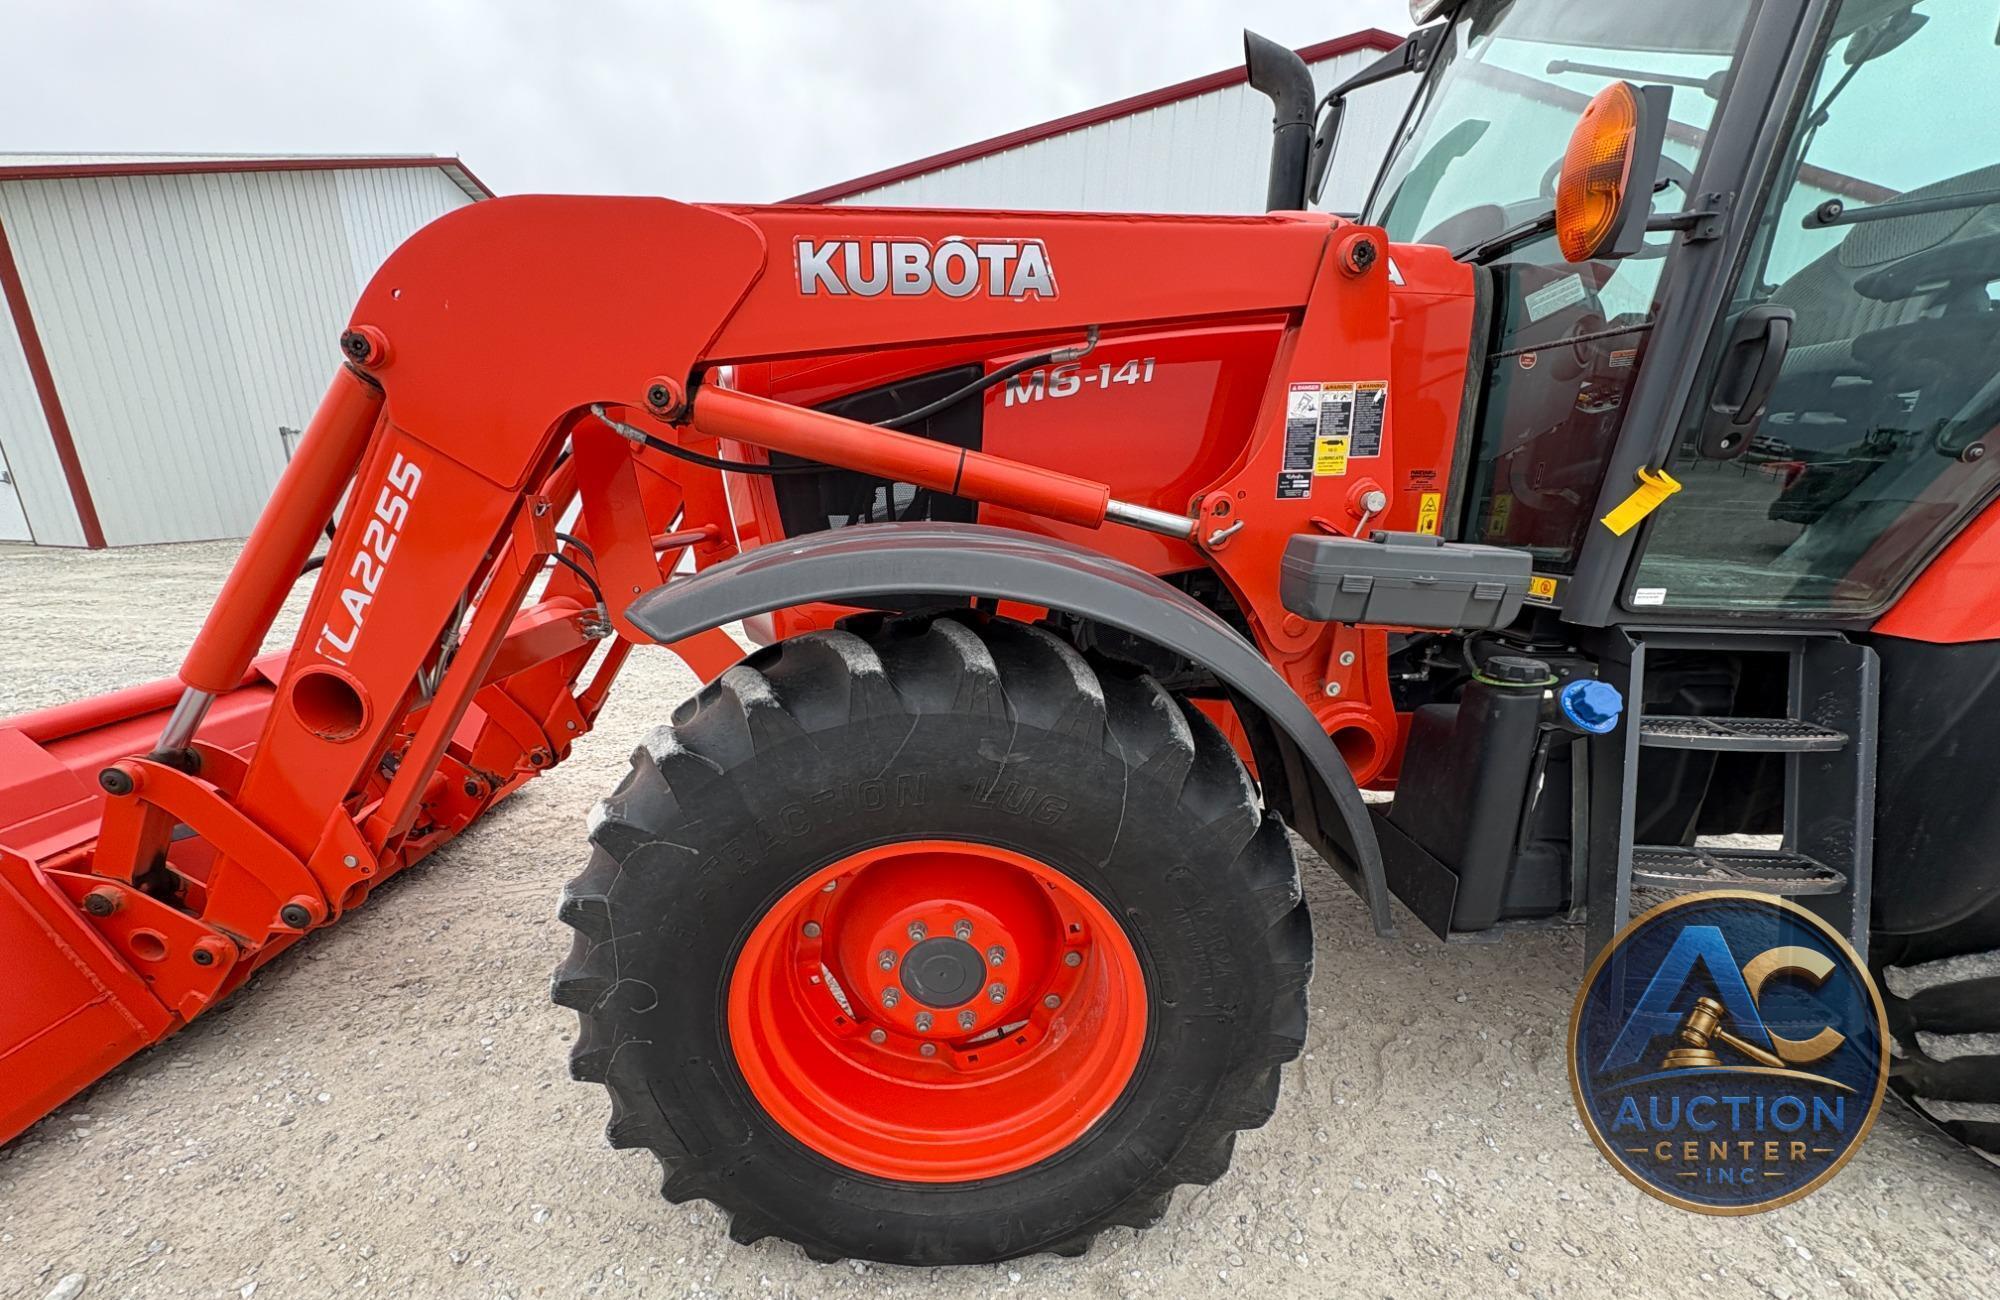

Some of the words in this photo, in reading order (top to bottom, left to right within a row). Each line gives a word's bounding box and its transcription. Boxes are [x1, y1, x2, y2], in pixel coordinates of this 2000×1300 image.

[797, 238, 1056, 298] KUBOTA
[1003, 356, 1157, 408] M6-141
[322, 452, 422, 654] LA2255
